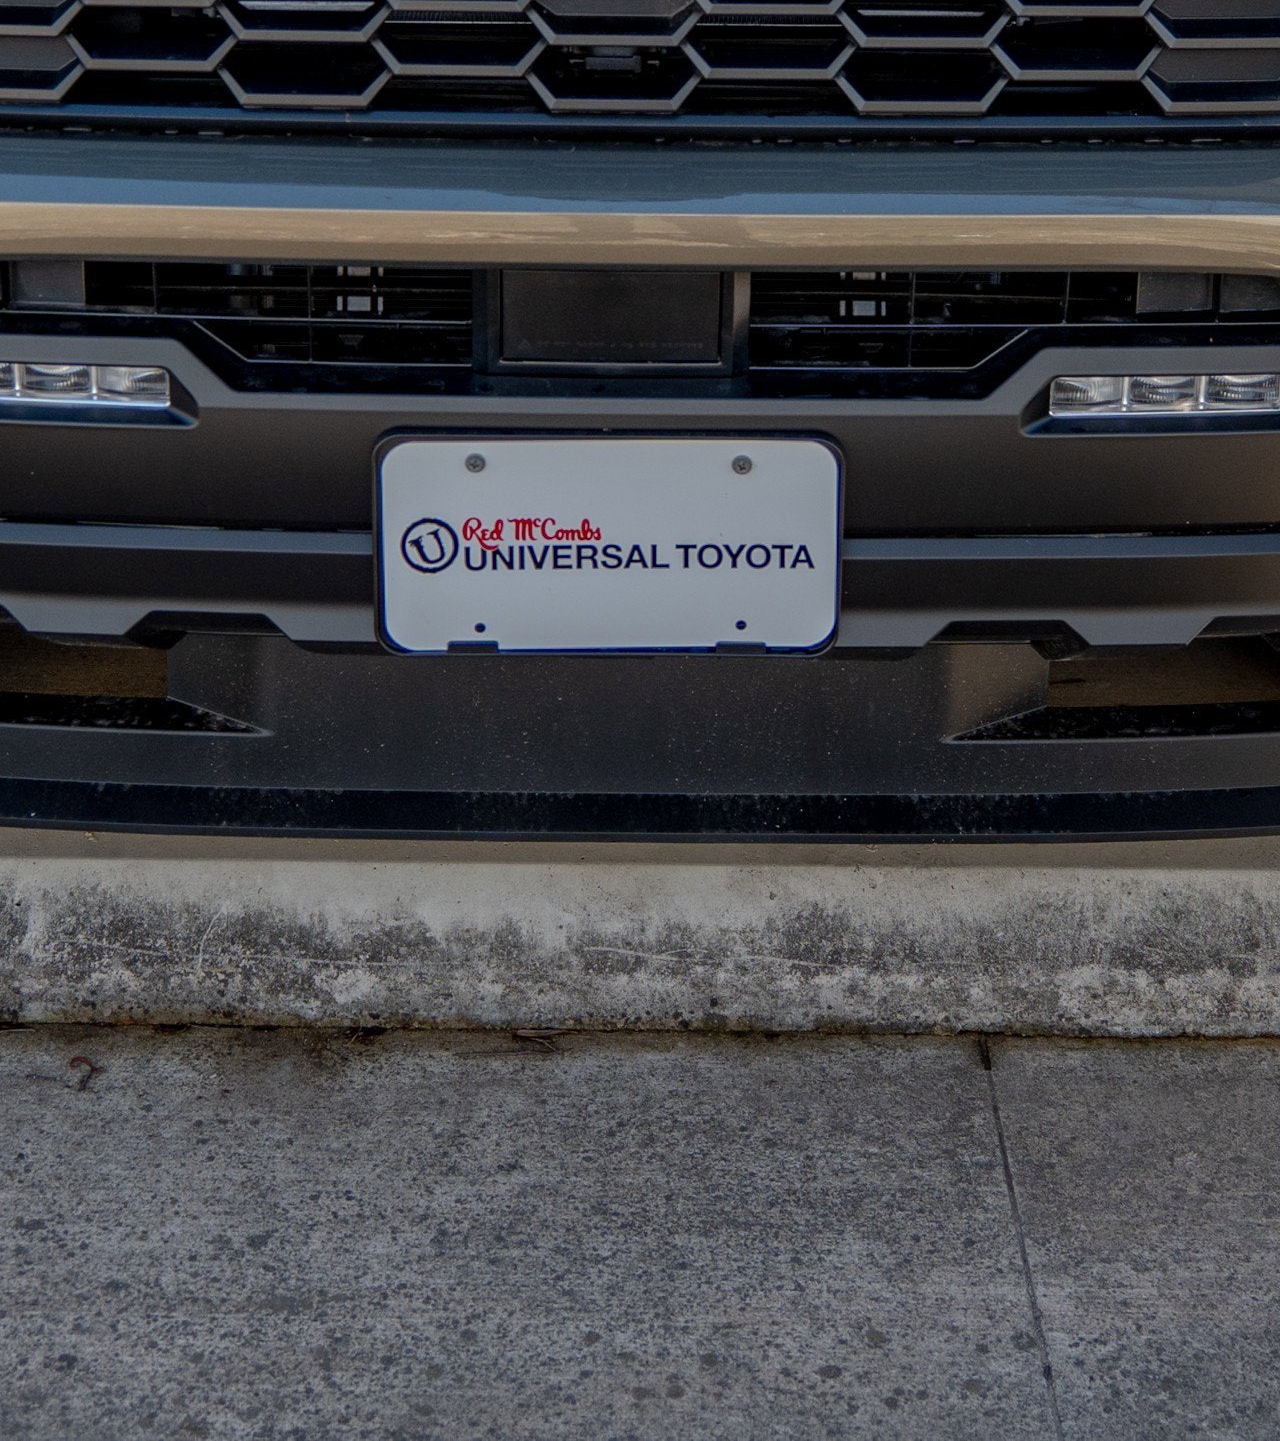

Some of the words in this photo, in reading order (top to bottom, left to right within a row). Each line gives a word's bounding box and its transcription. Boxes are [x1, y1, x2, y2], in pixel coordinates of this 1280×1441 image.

[462, 517, 505, 551] Red
[507, 517, 602, 542] McCombs
[464, 544, 670, 571] UNIVERSAL
[675, 544, 815, 569] TOYOTA
